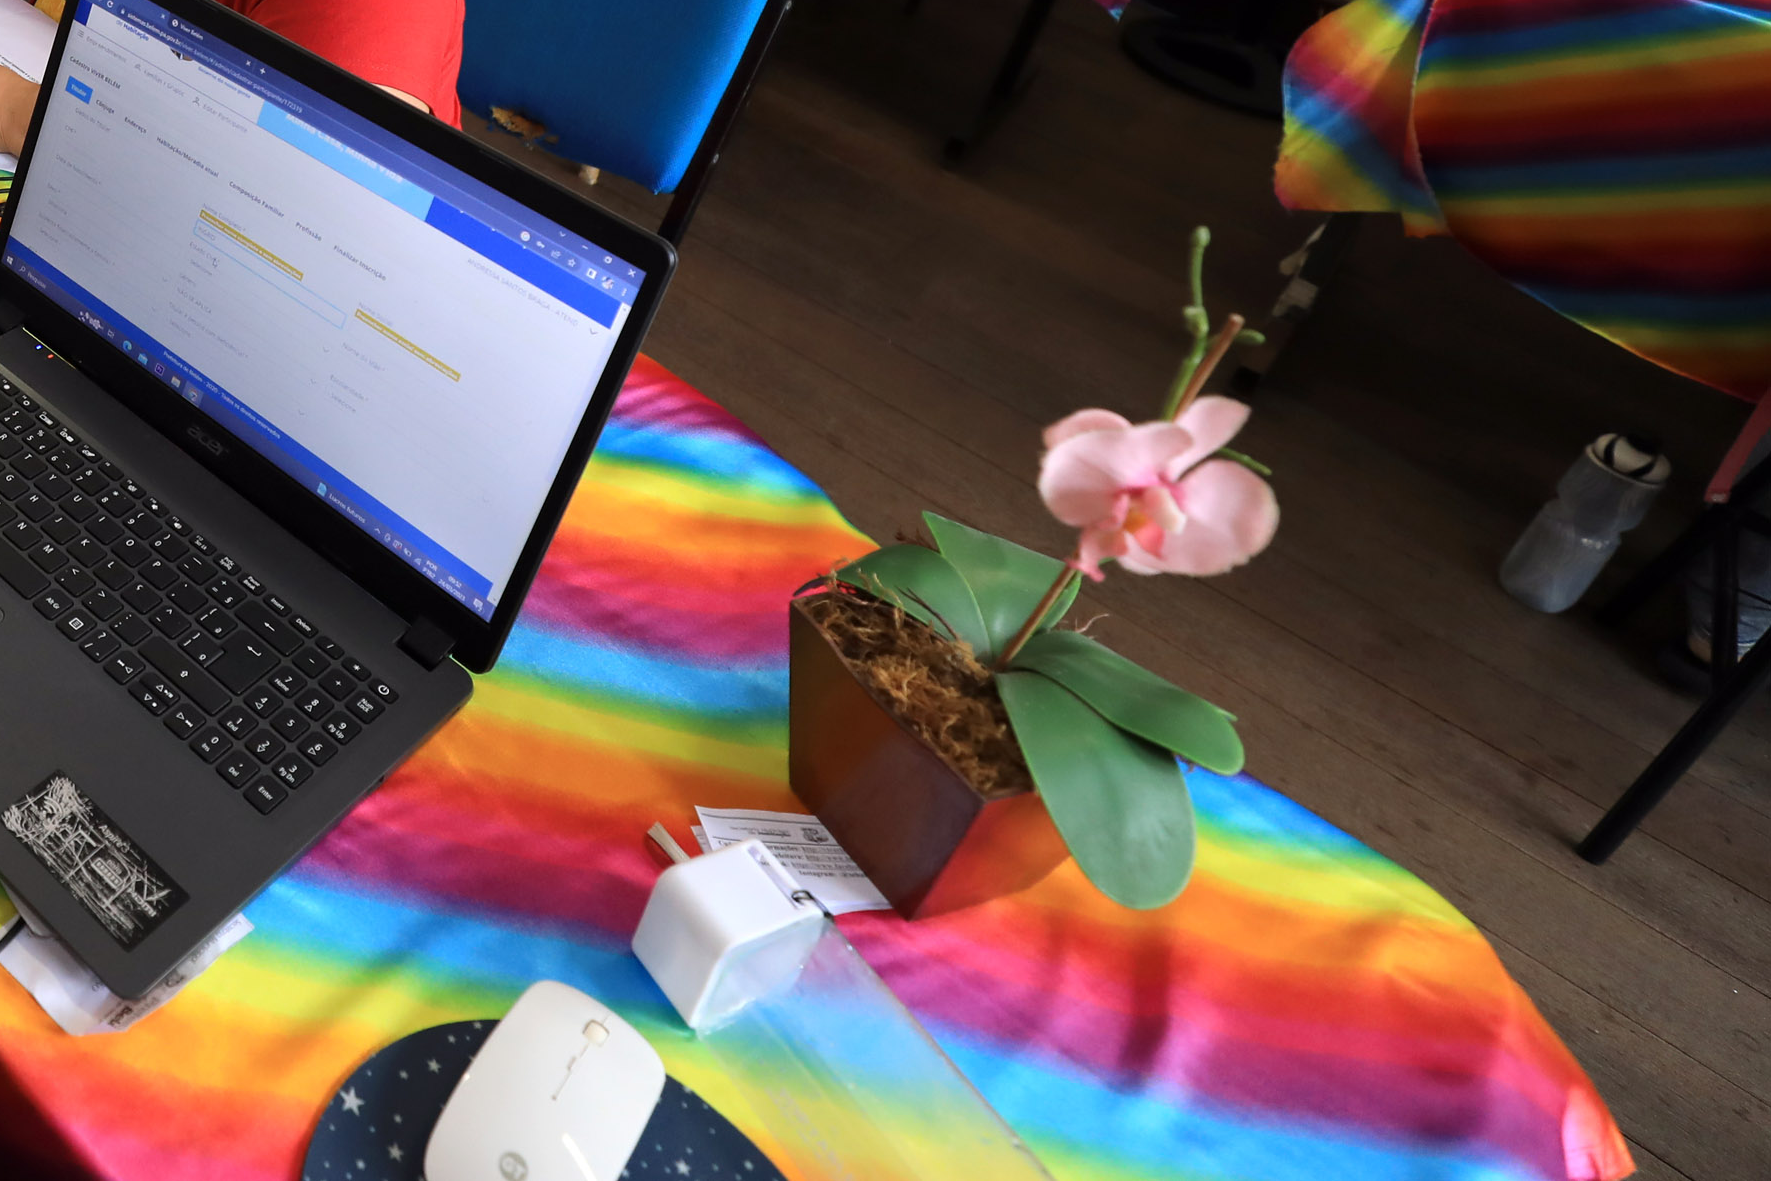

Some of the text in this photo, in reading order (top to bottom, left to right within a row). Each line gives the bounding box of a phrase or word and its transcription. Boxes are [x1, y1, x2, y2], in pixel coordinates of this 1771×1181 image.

[69, 54, 90, 72] Cadastro
[90, 67, 104, 80] VIVER
[123, 115, 147, 136] Endereço
[155, 135, 205, 171] Habitação/Moradia
[228, 179, 285, 219] Composição Familiar
[294, 220, 322, 242] Profissão
[332, 243, 387, 283] Finalizar Inscrição
[328, 492, 366, 524] Lucros futuros
[44, 545, 54, 553] M
[270, 598, 284, 610] Insert
[296, 618, 312, 631] Delete
[274, 678, 290, 692] Home
[357, 702, 370, 713] Lock
[361, 698, 374, 710] Num
[227, 721, 239, 732] End
[202, 743, 210, 752] Ins
[229, 767, 239, 777] Del
[258, 786, 273, 801] Enter
[98, 824, 121, 847] Aspire
